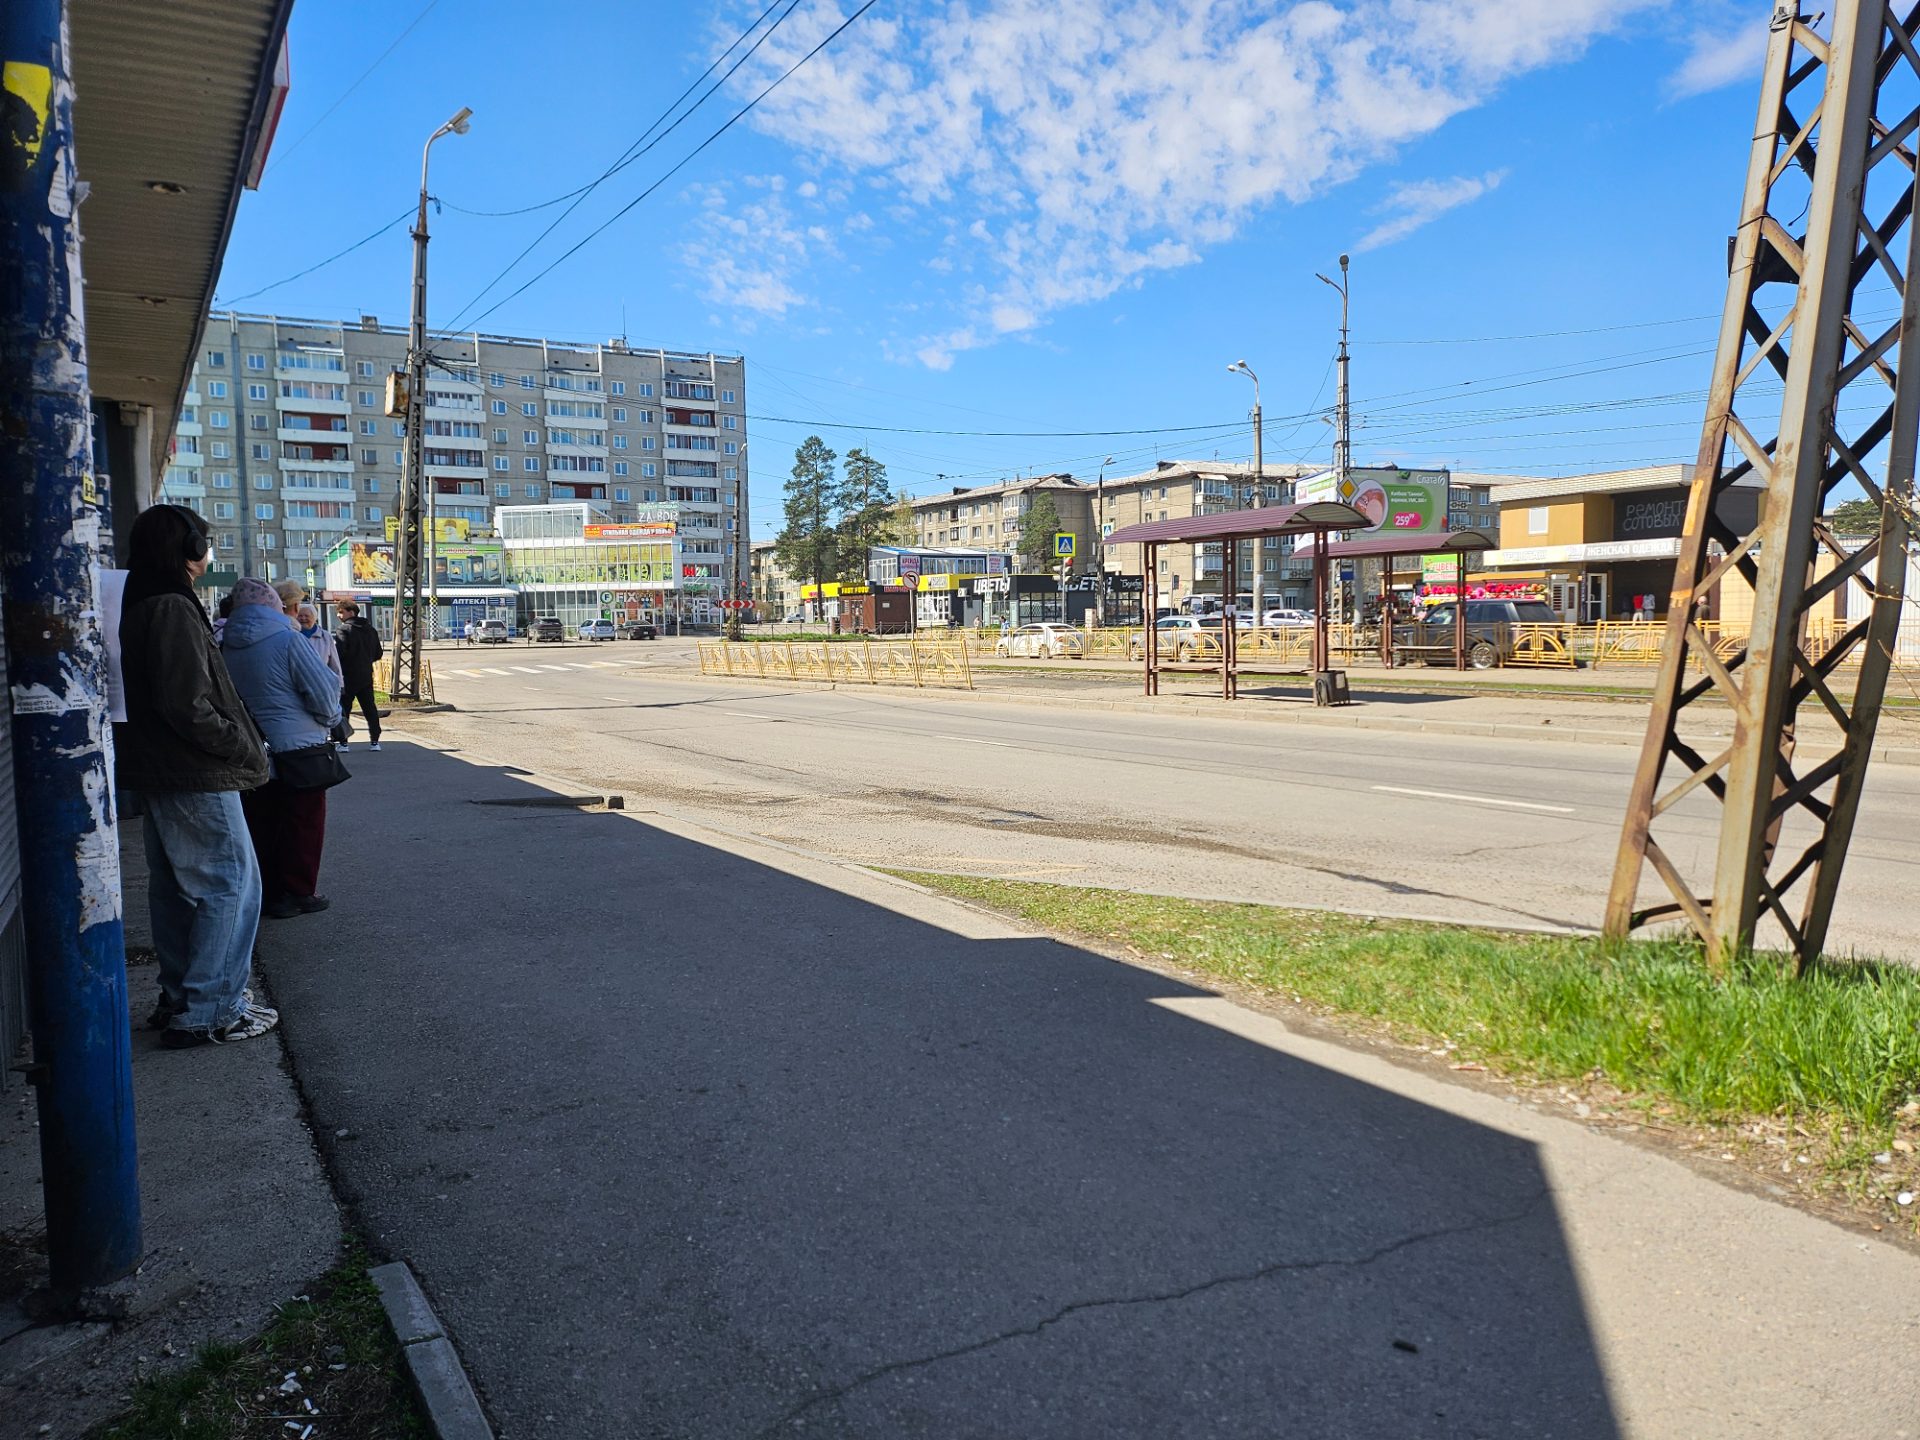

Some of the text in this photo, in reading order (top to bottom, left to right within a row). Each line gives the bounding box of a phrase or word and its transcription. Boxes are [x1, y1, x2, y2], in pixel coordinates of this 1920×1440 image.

[1416, 475, 1438, 484] Слата
[1395, 515, 1409, 526] 259
[1587, 543, 1630, 557] ЖЕНСКАЯ
[1632, 539, 1675, 554] ОДЕЖДА
[974, 577, 1011, 595] ЦВЕТЫ
